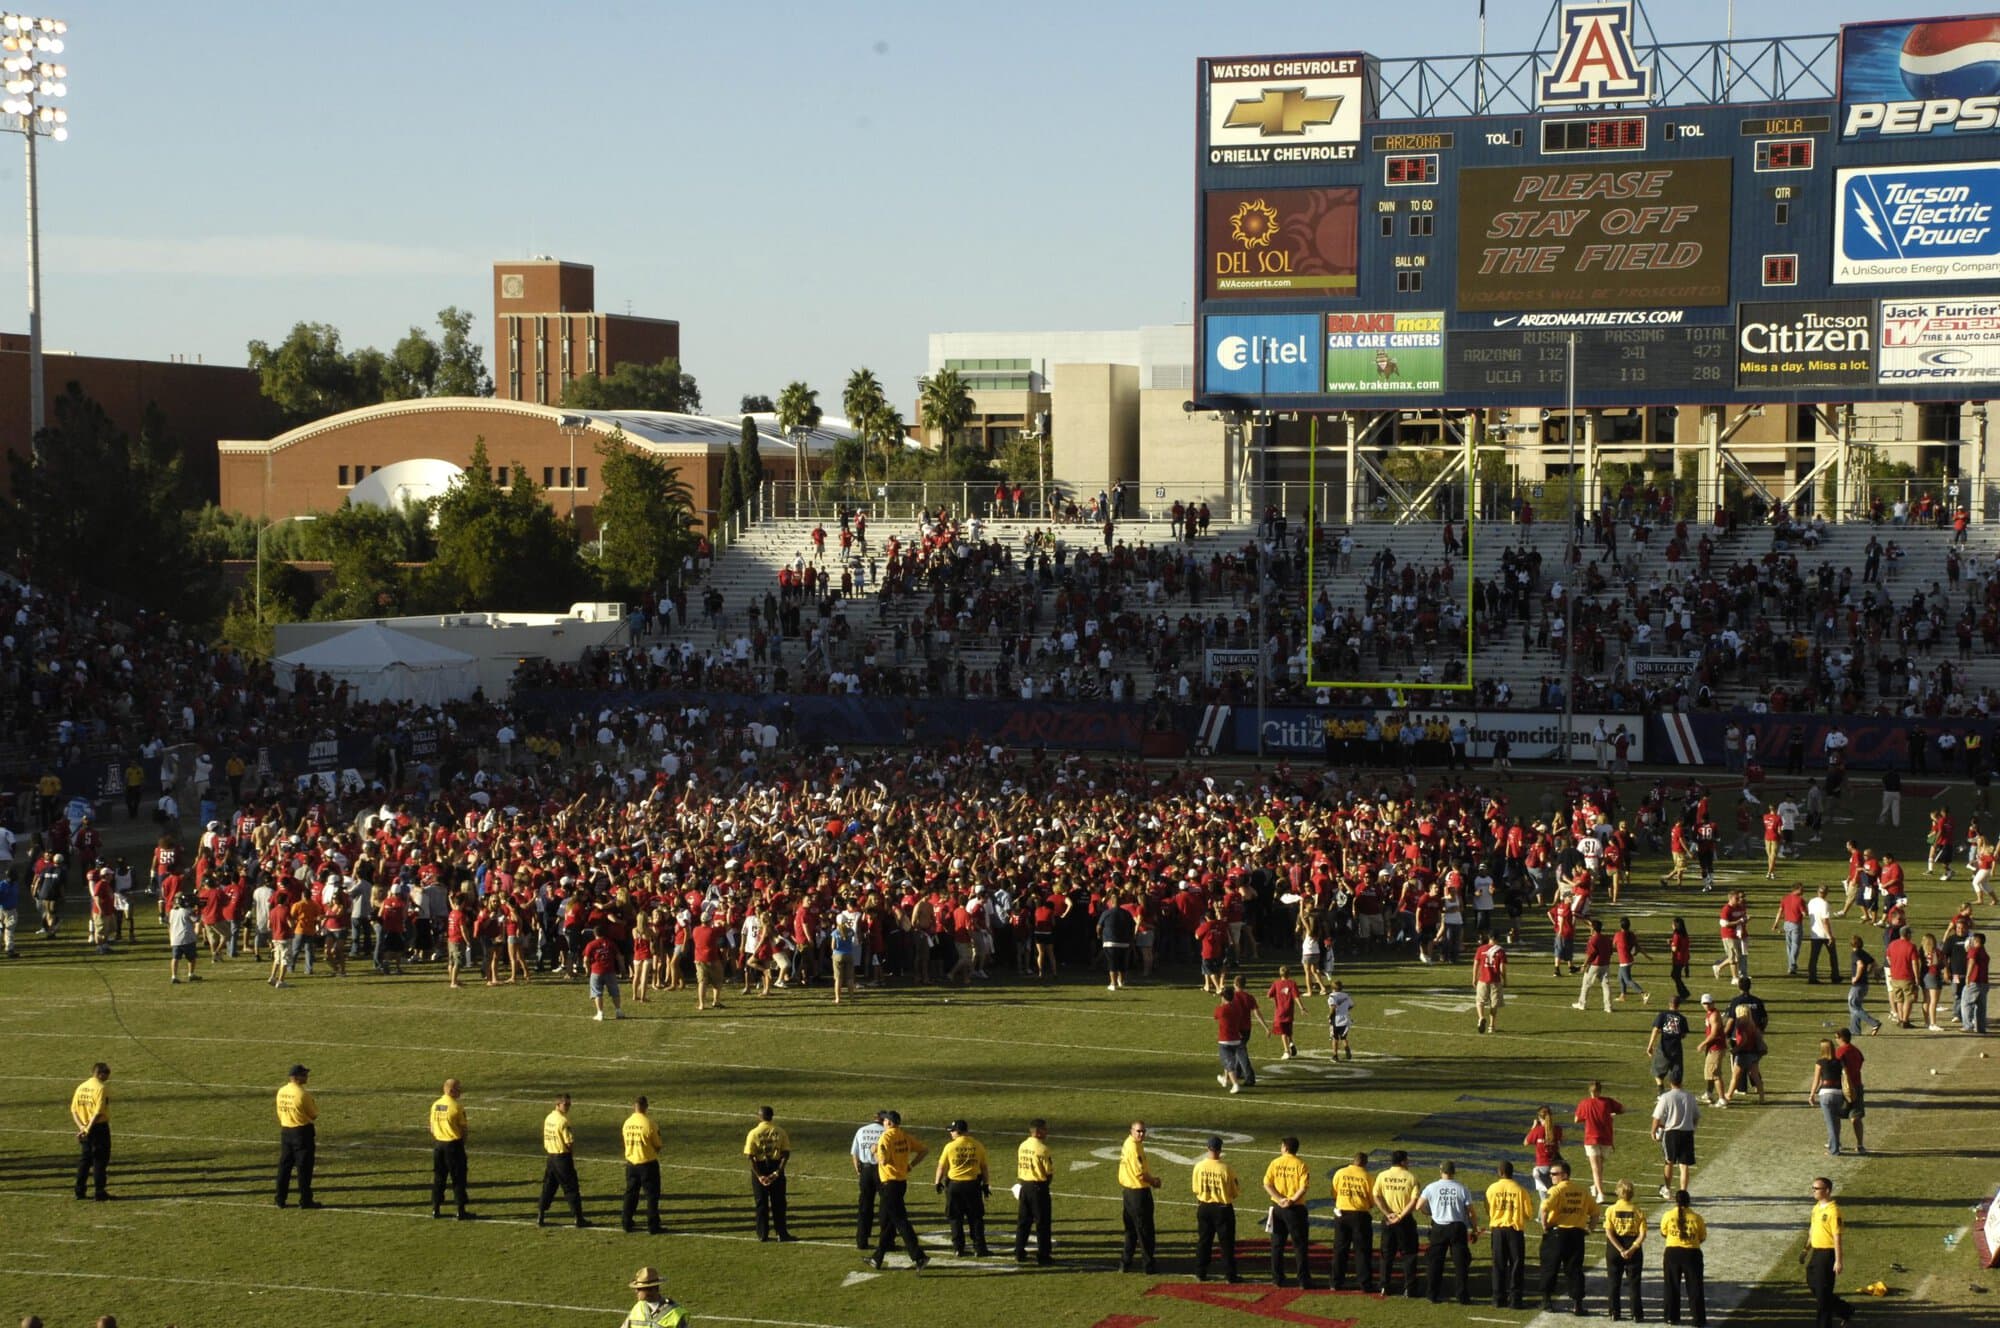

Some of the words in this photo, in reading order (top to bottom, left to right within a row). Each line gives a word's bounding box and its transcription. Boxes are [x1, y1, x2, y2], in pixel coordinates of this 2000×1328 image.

[1213, 64, 1270, 79] WATSON
[1273, 60, 1357, 77] CHEVROLET
[1843, 95, 2000, 137] PEPS
[1678, 125, 1704, 137] TOL
[1766, 119, 1803, 134] UCLA
[1386, 135, 1441, 150] ARIZONA
[1486, 133, 1511, 145] TOL
[1210, 148, 1270, 163] O'RIELLY
[1273, 146, 1356, 161] CHEVROLET
[1770, 143, 1811, 167] 27
[1513, 170, 1673, 203] PLEASE
[1775, 187, 1791, 199] QTR
[1884, 183, 1970, 205] Tucson
[1378, 202, 1396, 213] DWN
[1410, 201, 1420, 212] TO
[1421, 200, 1433, 211] GO
[1892, 202, 1992, 226] Electric
[1486, 209, 1591, 239] STAY
[1600, 205, 1699, 235] OFF
[1901, 225, 1991, 247] Power
[1216, 251, 1251, 274] DEL
[1259, 250, 1293, 273] SOL
[1395, 257, 1412, 268] BALL
[1413, 255, 1425, 267] ON
[1477, 246, 1565, 274] THE
[1574, 241, 1703, 273] FIELD
[1841, 266, 1849, 276] A
[1852, 263, 1908, 276] UniSource
[1911, 262, 1949, 276] Energy
[1952, 262, 2000, 273] Compan
[1219, 278, 1292, 289] AVAconcerts.com
[1517, 311, 1684, 327] ARIZONAATHLETICS.COM
[1886, 306, 1929, 318] Jack
[1327, 313, 1395, 334] BRAKE
[1395, 317, 1441, 332] max
[1803, 313, 1868, 328] Tucson
[1329, 335, 1353, 348] CAR
[1356, 334, 1387, 348] CARE
[1390, 333, 1441, 347] CENTERS
[1604, 329, 1665, 343] PASSING
[1685, 327, 1730, 341] TOTAL
[1741, 322, 1871, 354] Citizen
[1955, 333, 1981, 341] AUTO
[1463, 348, 1522, 362] ARIZONA
[1540, 347, 1563, 361] 132
[1621, 345, 1646, 360] 341
[1693, 344, 1721, 358] 473
[1486, 369, 1521, 383] UCLA
[1692, 366, 1721, 380] 288
[1740, 362, 1768, 373] Miss
[1770, 364, 1778, 372] a
[1781, 361, 1805, 374] day.
[1808, 361, 1837, 371] Miss
[1850, 360, 1869, 371] lot.
[1328, 380, 1440, 391] www.brakemax.com
[1262, 719, 1325, 748] Citiz
[1468, 726, 1637, 746] tucsoncitizeno
